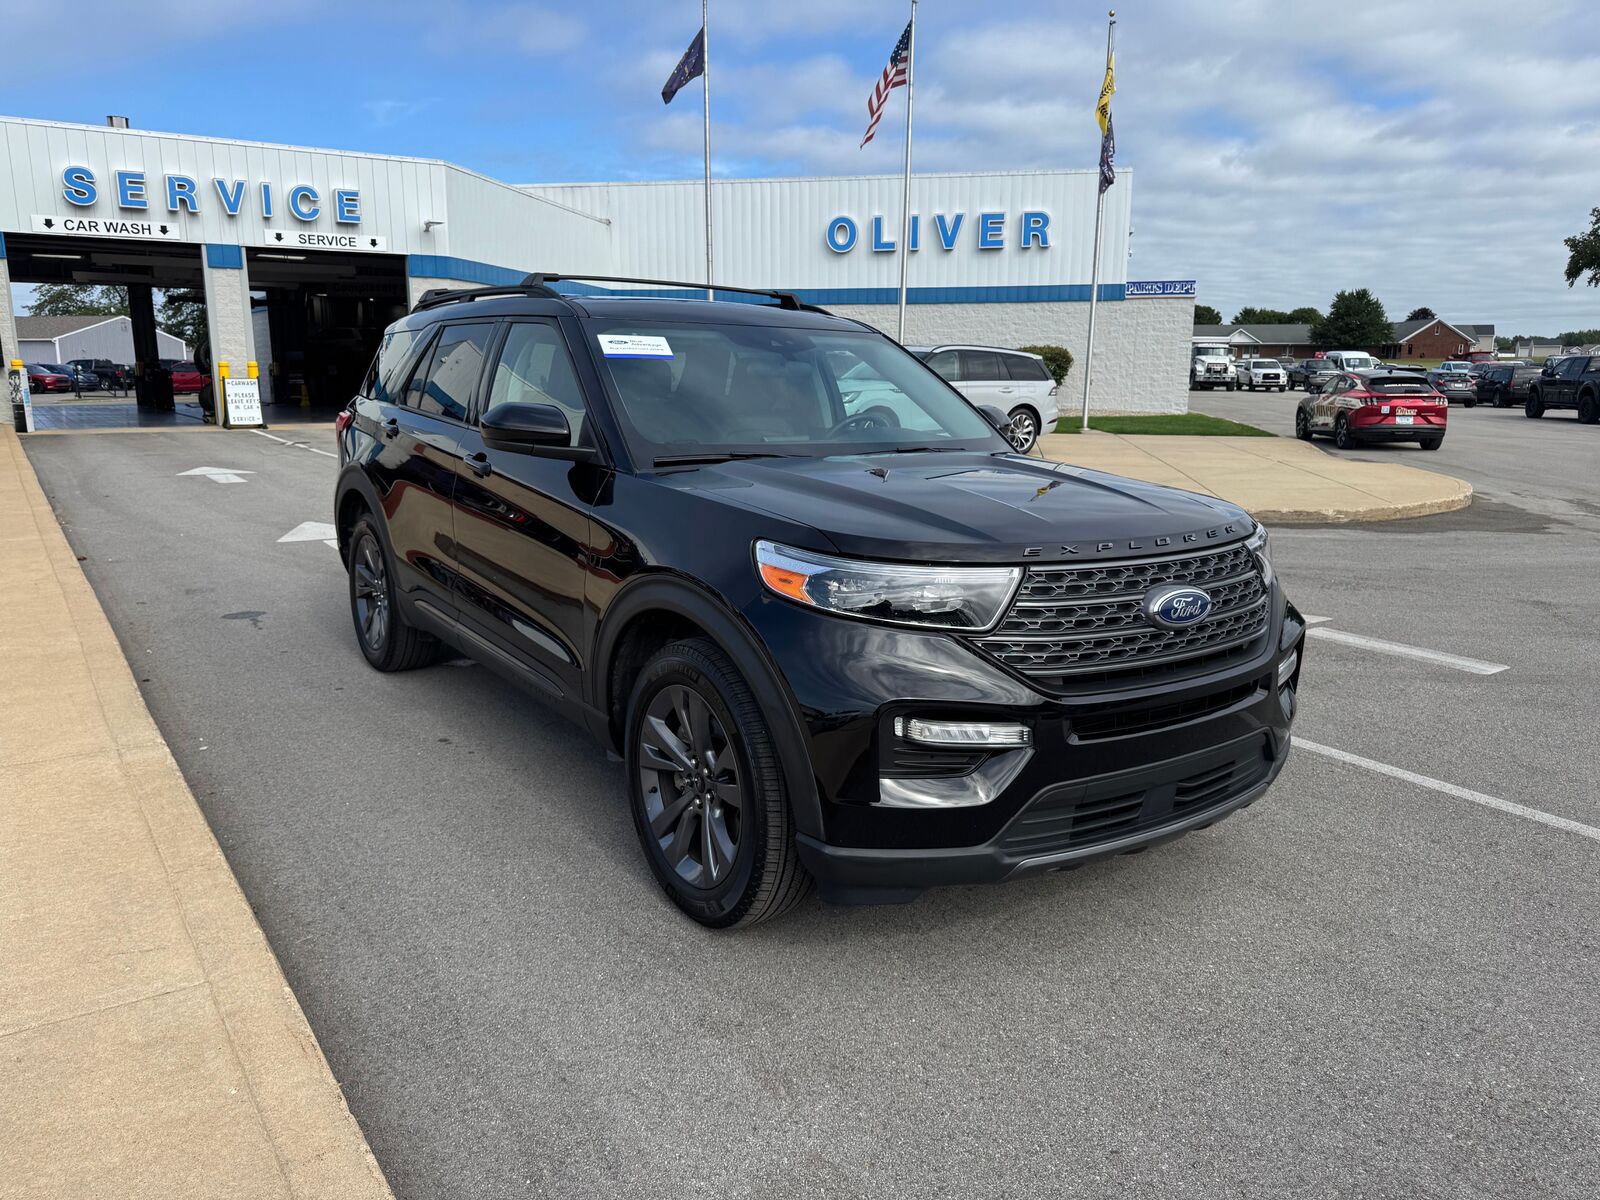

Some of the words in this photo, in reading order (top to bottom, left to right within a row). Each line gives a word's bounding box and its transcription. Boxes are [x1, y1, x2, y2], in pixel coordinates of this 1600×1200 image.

[62, 165, 362, 225] SERVICE
[63, 218, 101, 233] CAR
[104, 220, 152, 236] WASH
[826, 210, 1052, 254] OLIVER
[298, 233, 357, 248] SERVICE
[1126, 283, 1162, 294] PARTS
[1164, 282, 1195, 293] DEPT
[1023, 525, 1236, 557] EXPLORER
[1171, 597, 1201, 619] Ford
